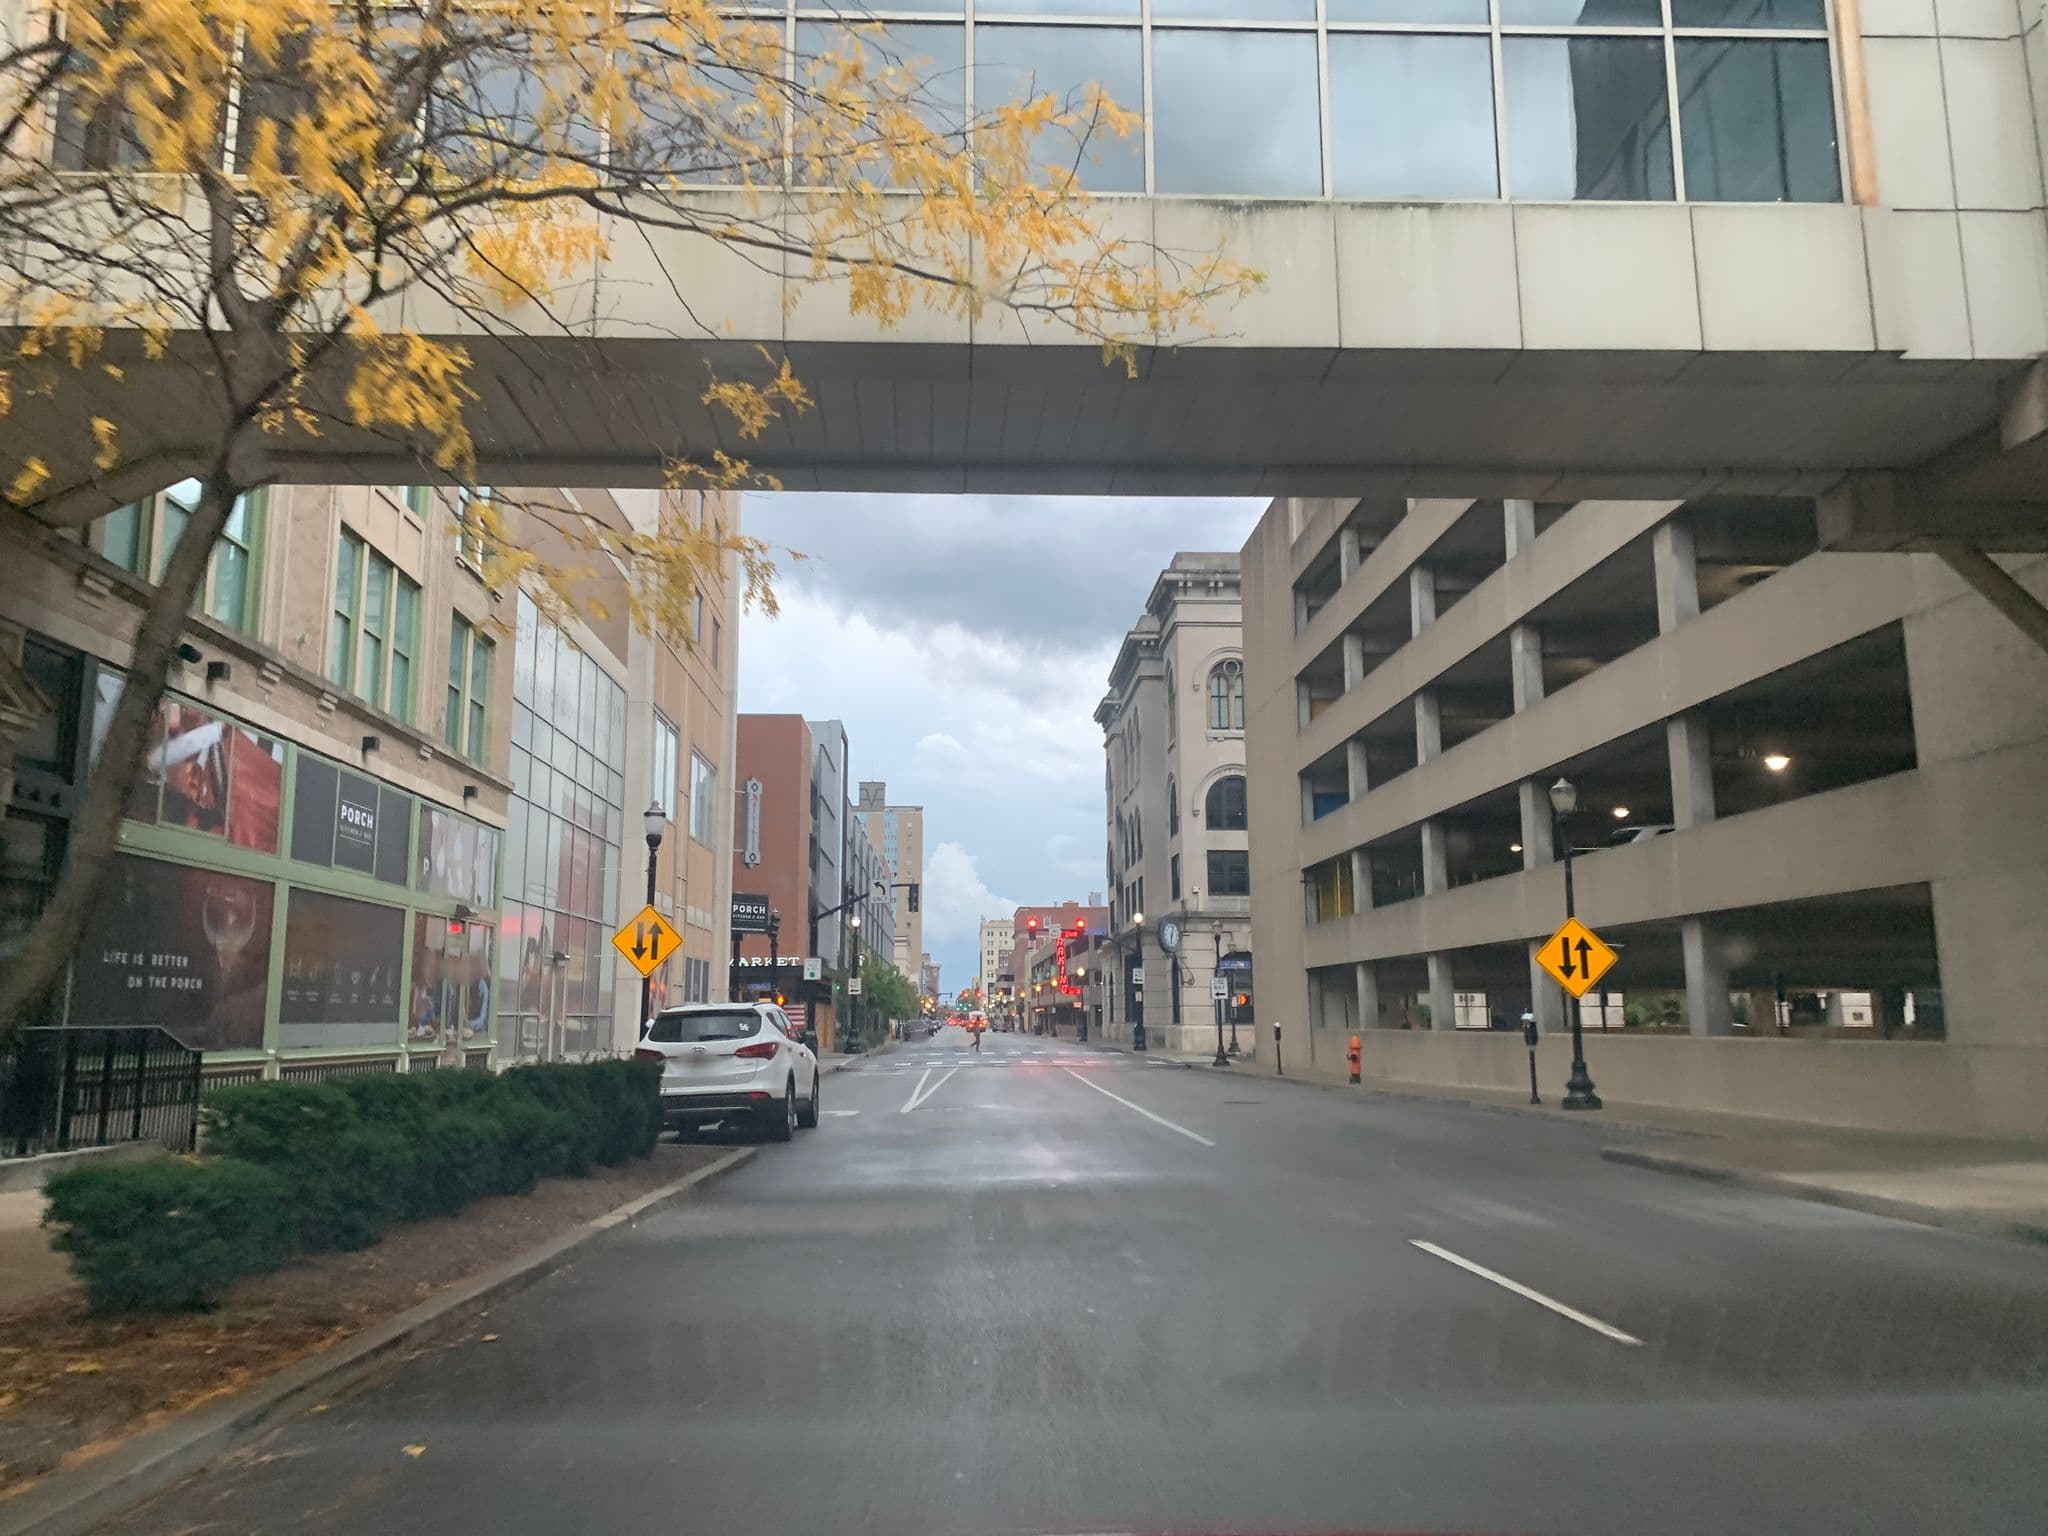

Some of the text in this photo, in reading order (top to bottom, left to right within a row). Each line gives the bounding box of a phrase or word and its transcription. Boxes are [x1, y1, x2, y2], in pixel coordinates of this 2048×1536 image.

[341, 804, 374, 829] PORCH
[732, 904, 766, 914] PORCH
[133, 953, 144, 966] IS
[729, 957, 800, 967] ARKET
[128, 976, 203, 990] ON THE PORCH
